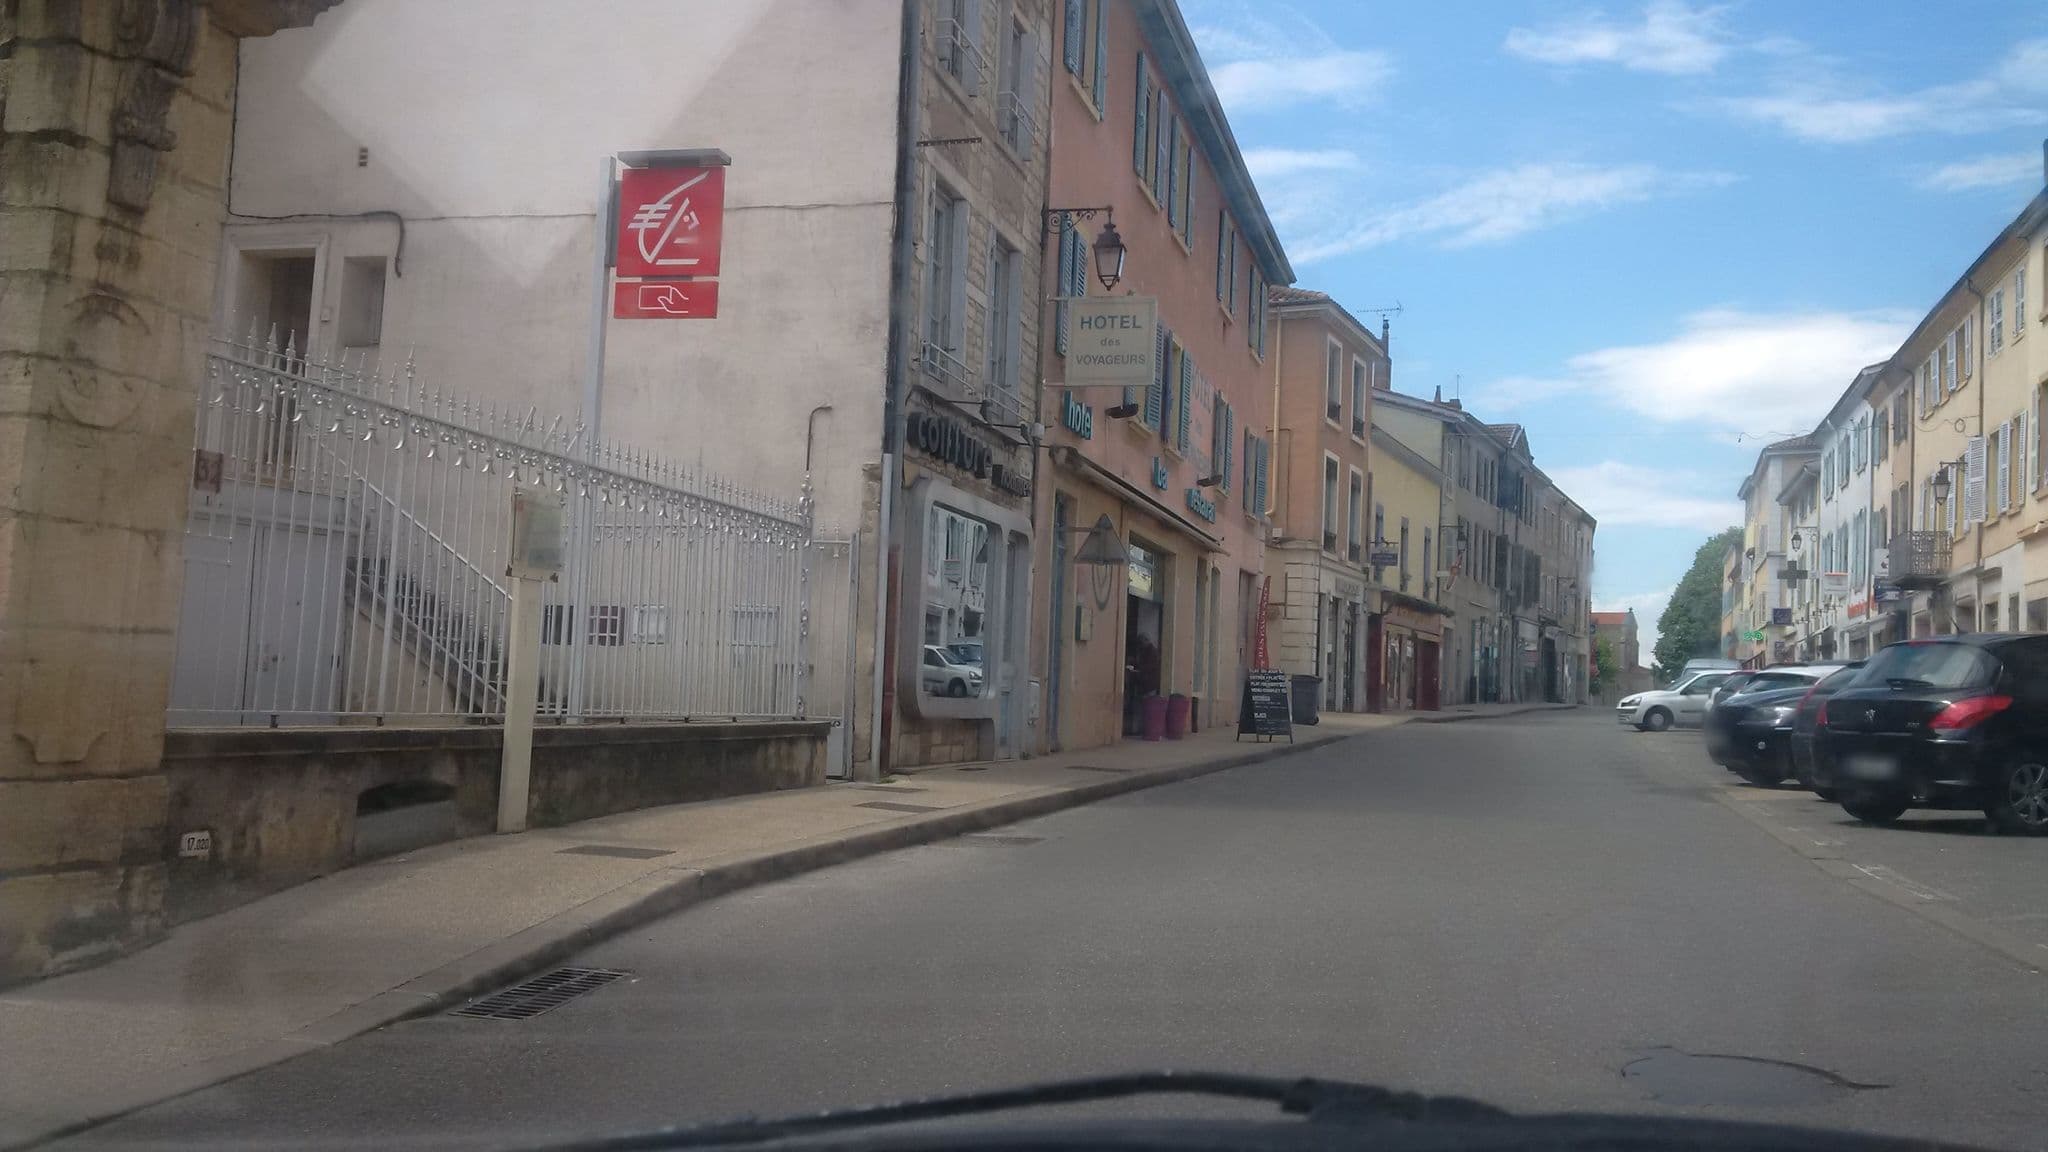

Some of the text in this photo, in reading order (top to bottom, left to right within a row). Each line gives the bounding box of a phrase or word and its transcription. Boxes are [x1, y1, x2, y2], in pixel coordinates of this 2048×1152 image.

[1081, 315, 1142, 330] HOTEL
[1100, 337, 1121, 346] des
[1076, 354, 1146, 366] VOYAGEURS
[1064, 390, 1094, 440] hotel
[907, 412, 993, 479] coiffure
